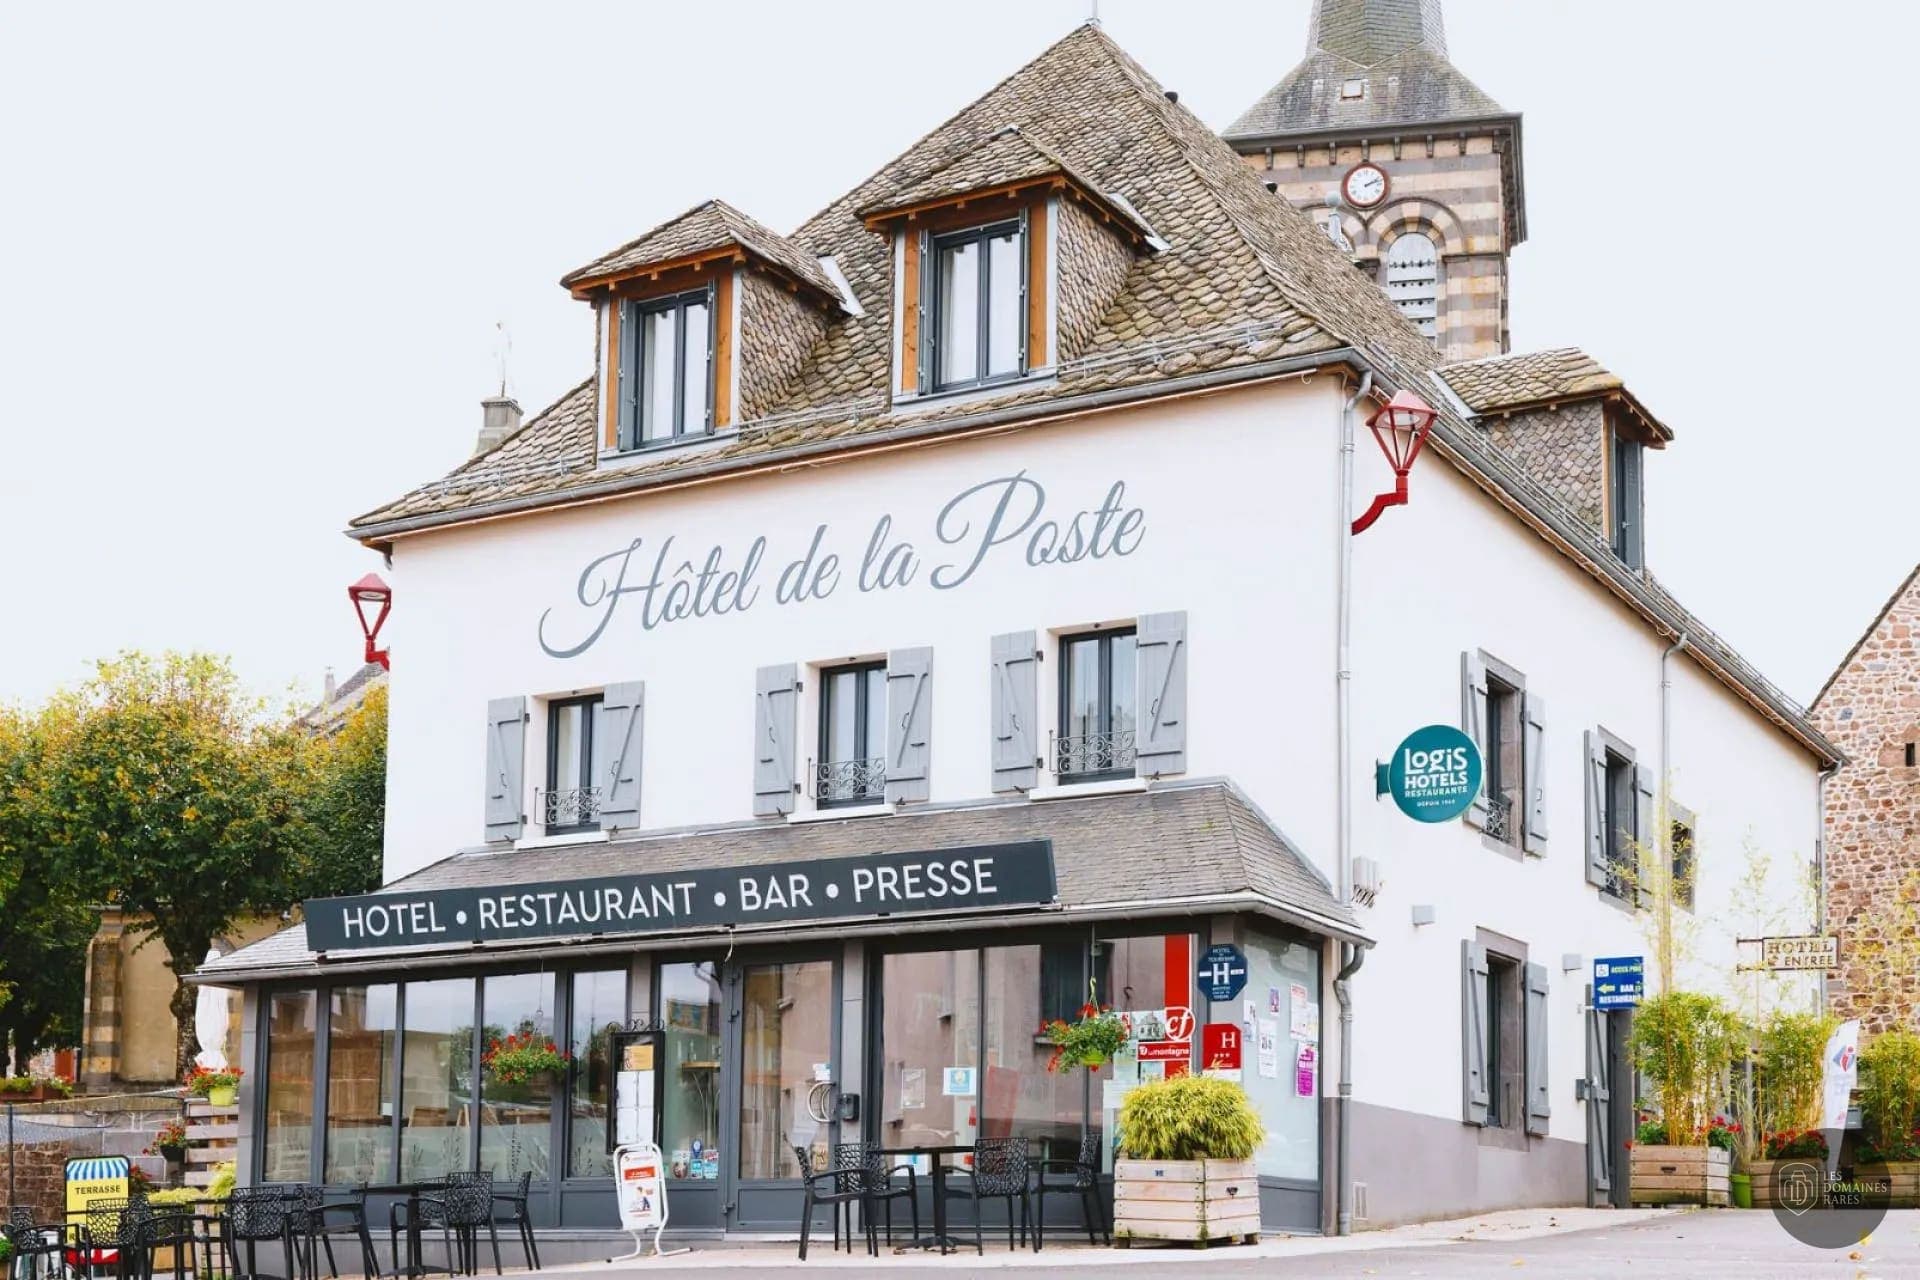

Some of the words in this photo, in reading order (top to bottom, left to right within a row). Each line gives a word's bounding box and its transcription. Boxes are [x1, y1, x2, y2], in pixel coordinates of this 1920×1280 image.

[538, 535, 767, 658] Hôtel
[775, 525, 841, 604] de
[858, 514, 920, 590] la
[930, 469, 1146, 590] Poste
[1404, 771, 1468, 790] HOTELS
[342, 902, 447, 939] HOTEL
[480, 882, 697, 931] RESTAURANT
[739, 873, 814, 912] BAR
[853, 857, 998, 903] PRESSE
[1767, 941, 1833, 954] HOTEL
[1212, 962, 1230, 985] H
[1221, 1031, 1236, 1049] H
[75, 1184, 121, 1195] TERRASSE
